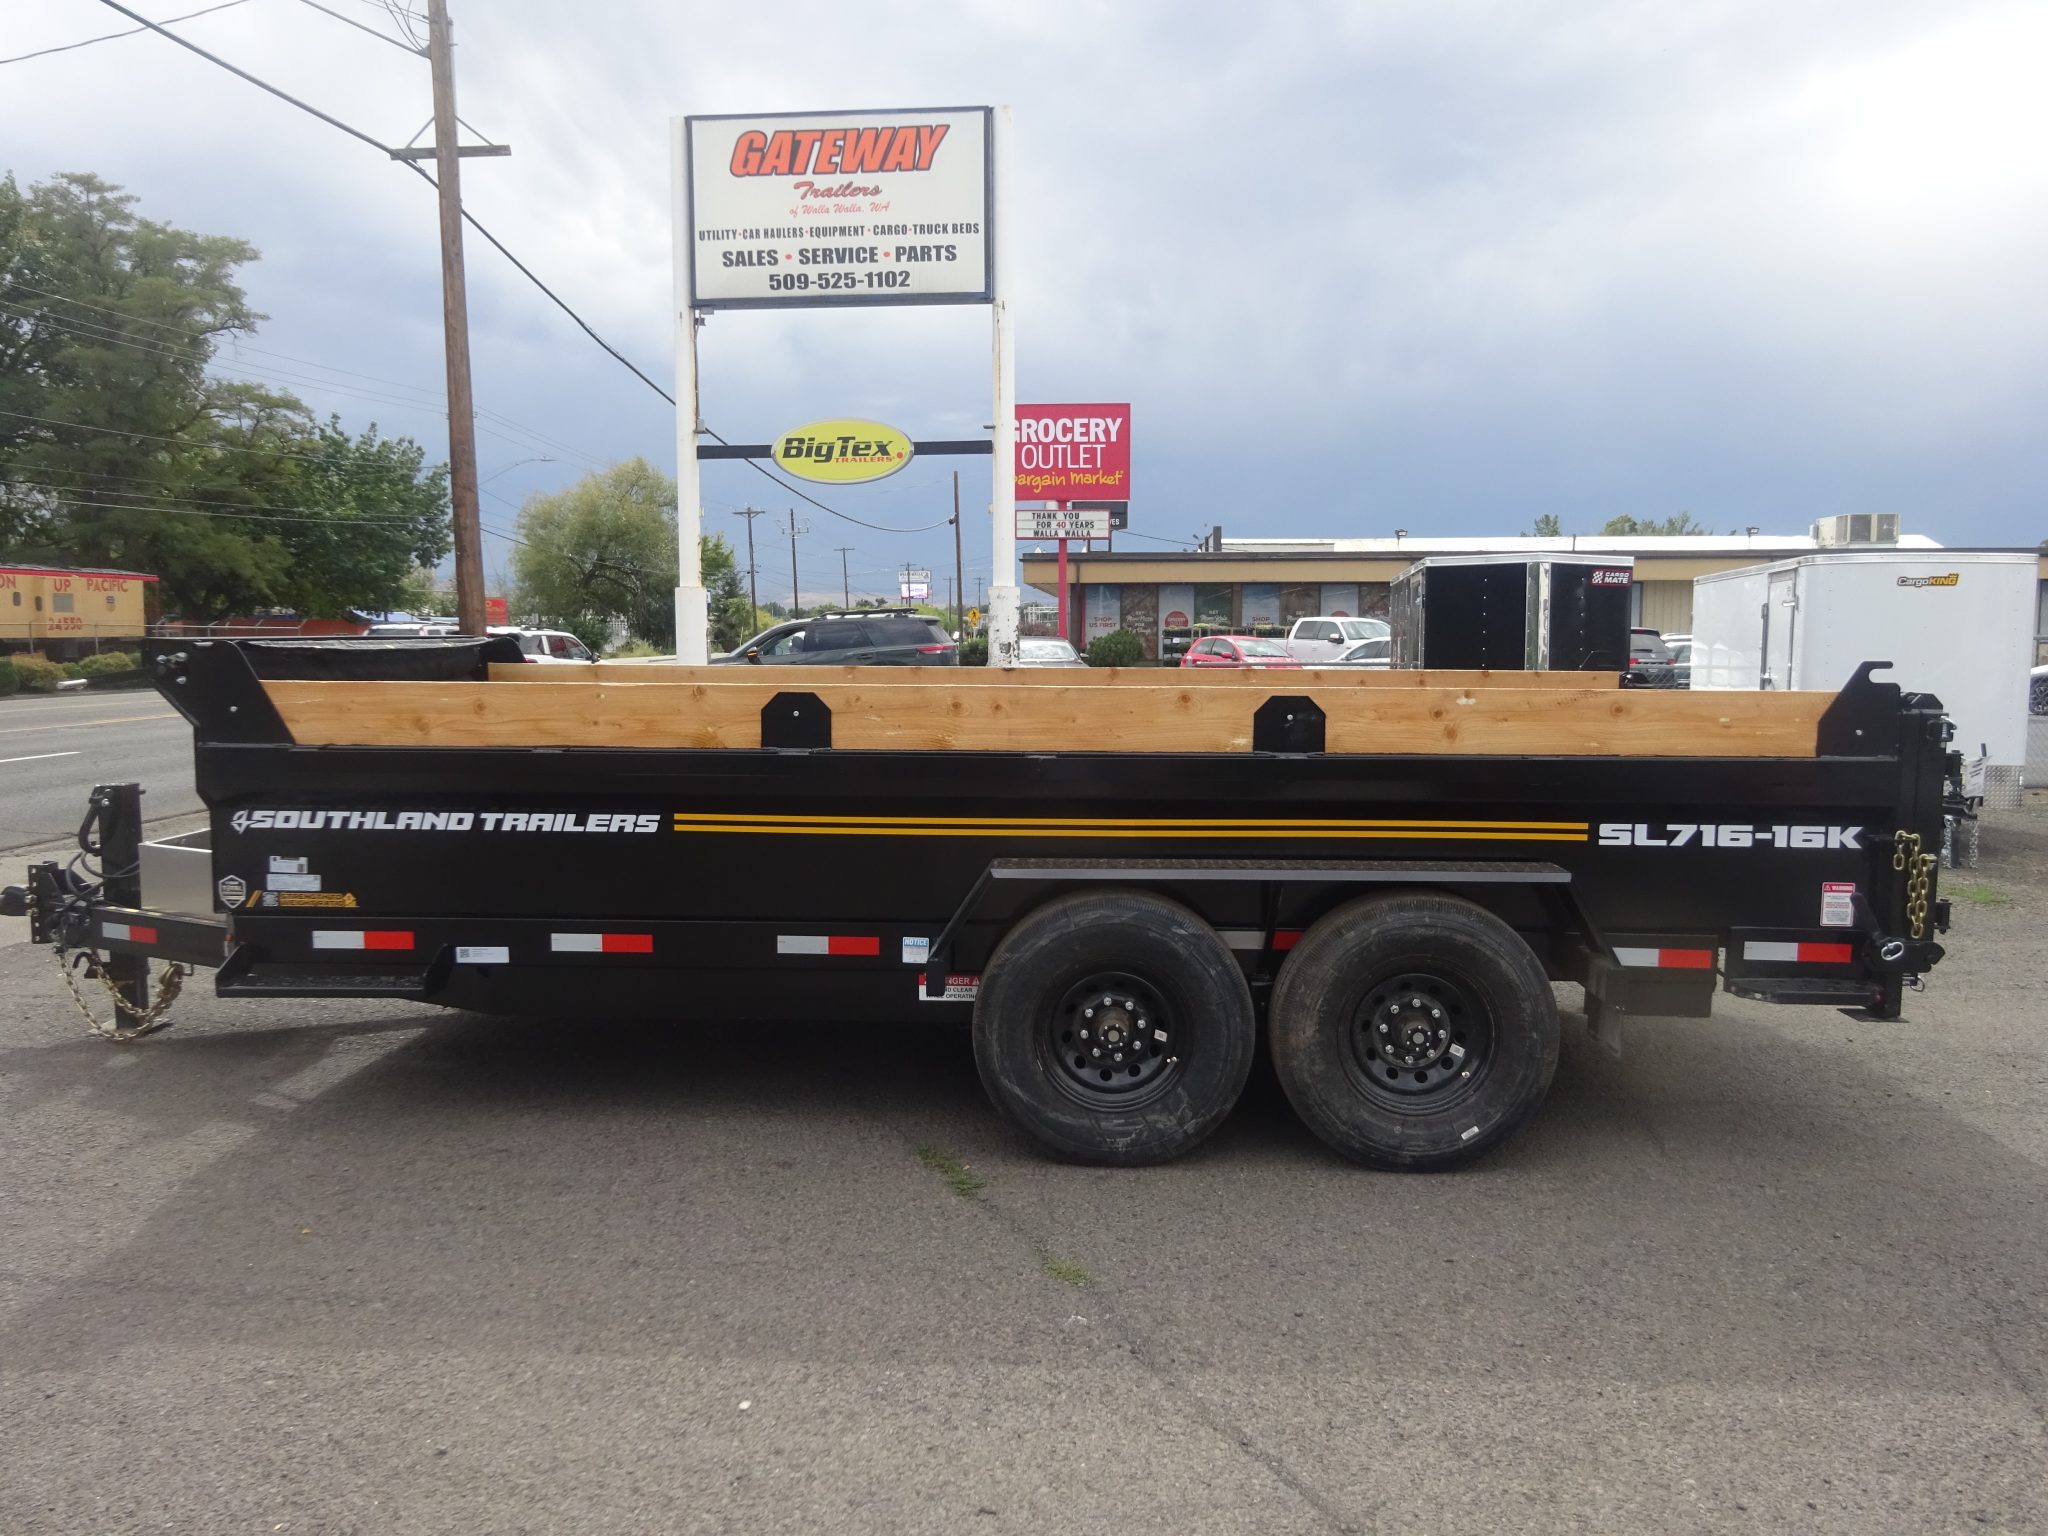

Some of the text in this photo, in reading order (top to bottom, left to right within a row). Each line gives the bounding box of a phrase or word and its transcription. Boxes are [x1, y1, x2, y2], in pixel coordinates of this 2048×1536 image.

[730, 124, 950, 178] GATEWAY
[793, 181, 882, 200] Trailers
[789, 205, 800, 218] of
[801, 204, 830, 214] Walla
[869, 201, 891, 212] WA
[699, 222, 980, 241] UTILITY CAR HAULERS EQUIPMENT CARGO TRUCK BEDS
[722, 244, 957, 268] SALES SERVICE PARTS
[769, 270, 911, 291] 509-525-1102
[1021, 444, 1106, 469] OUTLET
[1032, 512, 1080, 520] THANK YOU
[1036, 521, 1094, 529] FOR 40 YEARS
[1033, 529, 1091, 537] WALLA WALLA
[54, 578, 71, 592] UP
[87, 578, 128, 592] PACIFIC
[250, 810, 661, 833] SOUTHLAND TRAILERS
[1598, 823, 1863, 849] SL716-16K
[904, 938, 928, 946] NOTICE
